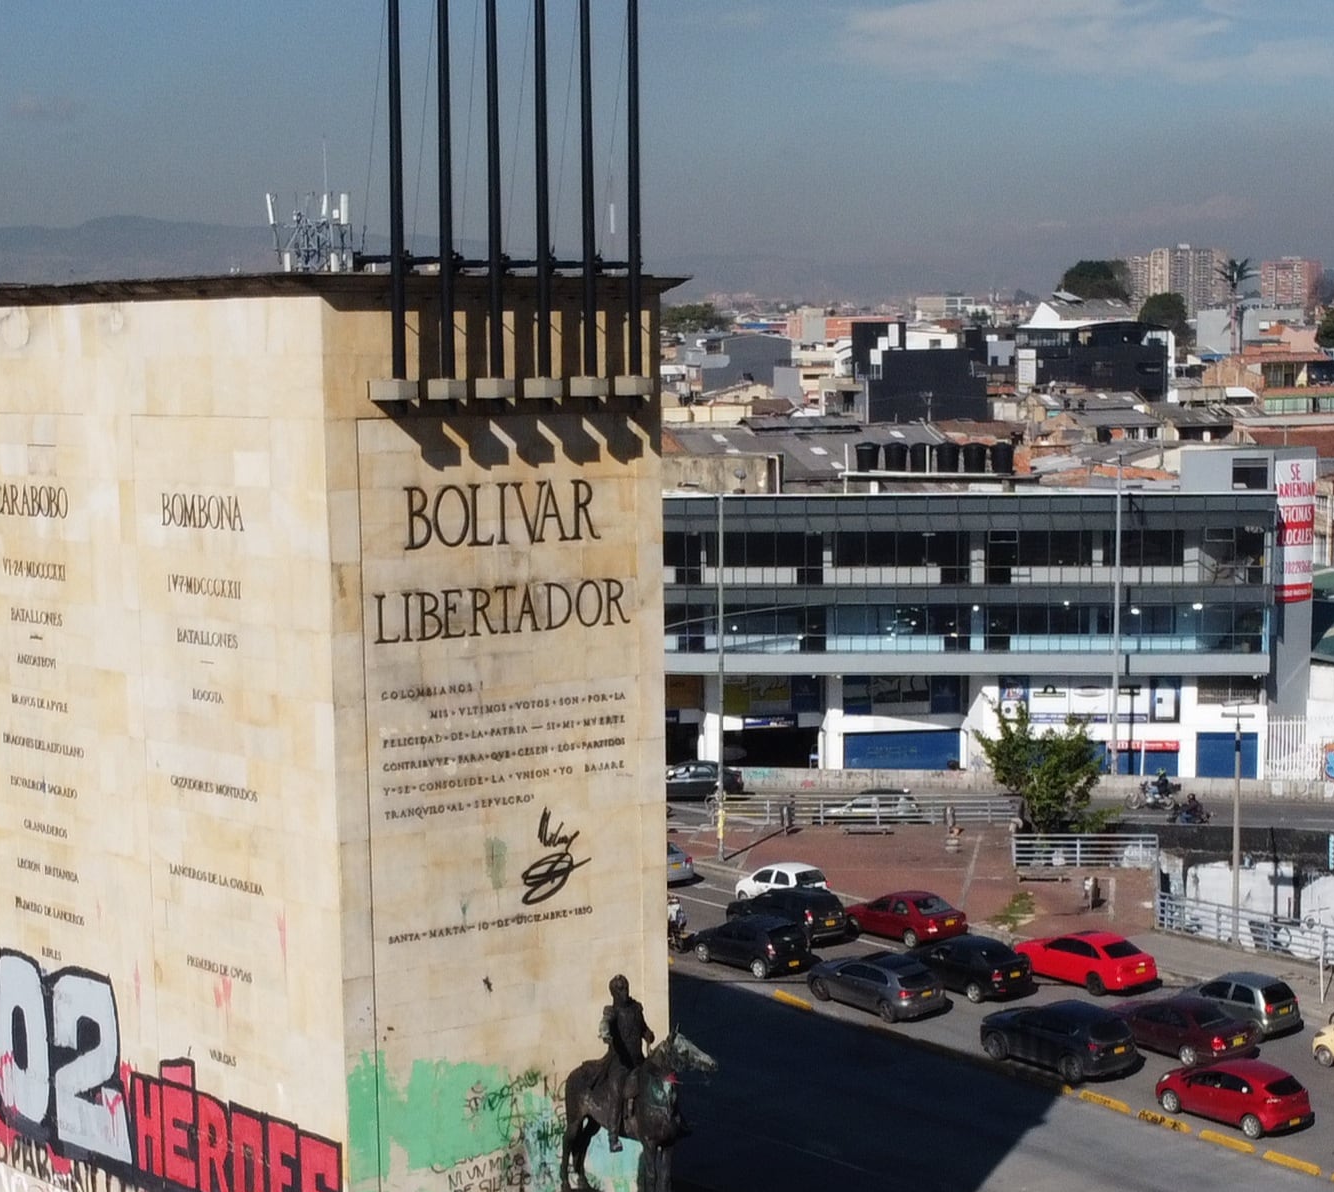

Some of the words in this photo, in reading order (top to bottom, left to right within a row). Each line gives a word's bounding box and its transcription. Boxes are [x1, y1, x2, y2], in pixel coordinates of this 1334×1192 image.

[1290, 463, 1301, 480] SE
[161, 493, 244, 531] BOMBONA
[403, 478, 601, 550] BOLIVAR
[11, 607, 63, 627] BATALLONES
[374, 578, 631, 644] LIBERTADOR
[177, 628, 238, 649] BATALLONES
[192, 688, 224, 704] BOGOTA
[381, 682, 473, 701] COLOMBIANOS
[430, 704, 449, 719] MIS
[460, 703, 507, 717] VLTIMOS
[515, 697, 550, 711] VOTOS
[558, 696, 579, 707] SON
[587, 694, 608, 704] POR
[614, 691, 626, 701] LA
[451, 731, 464, 742] DE
[471, 729, 484, 739] LA
[490, 725, 528, 738] PATRIA
[458, 752, 484, 764] PARA
[557, 743, 576, 753] LOS
[398, 784, 411, 795] SE
[418, 776, 484, 792] CONSOLIDE
[491, 774, 506, 785] LA
[560, 766, 573, 776] YO
[584, 760, 625, 773] BAJARE
[450, 801, 465, 812] AL
[388, 931, 421, 945] SANTA
[429, 925, 466, 940] MARTA
[497, 917, 511, 929] DE
[517, 912, 568, 926] DICIEMBRE
